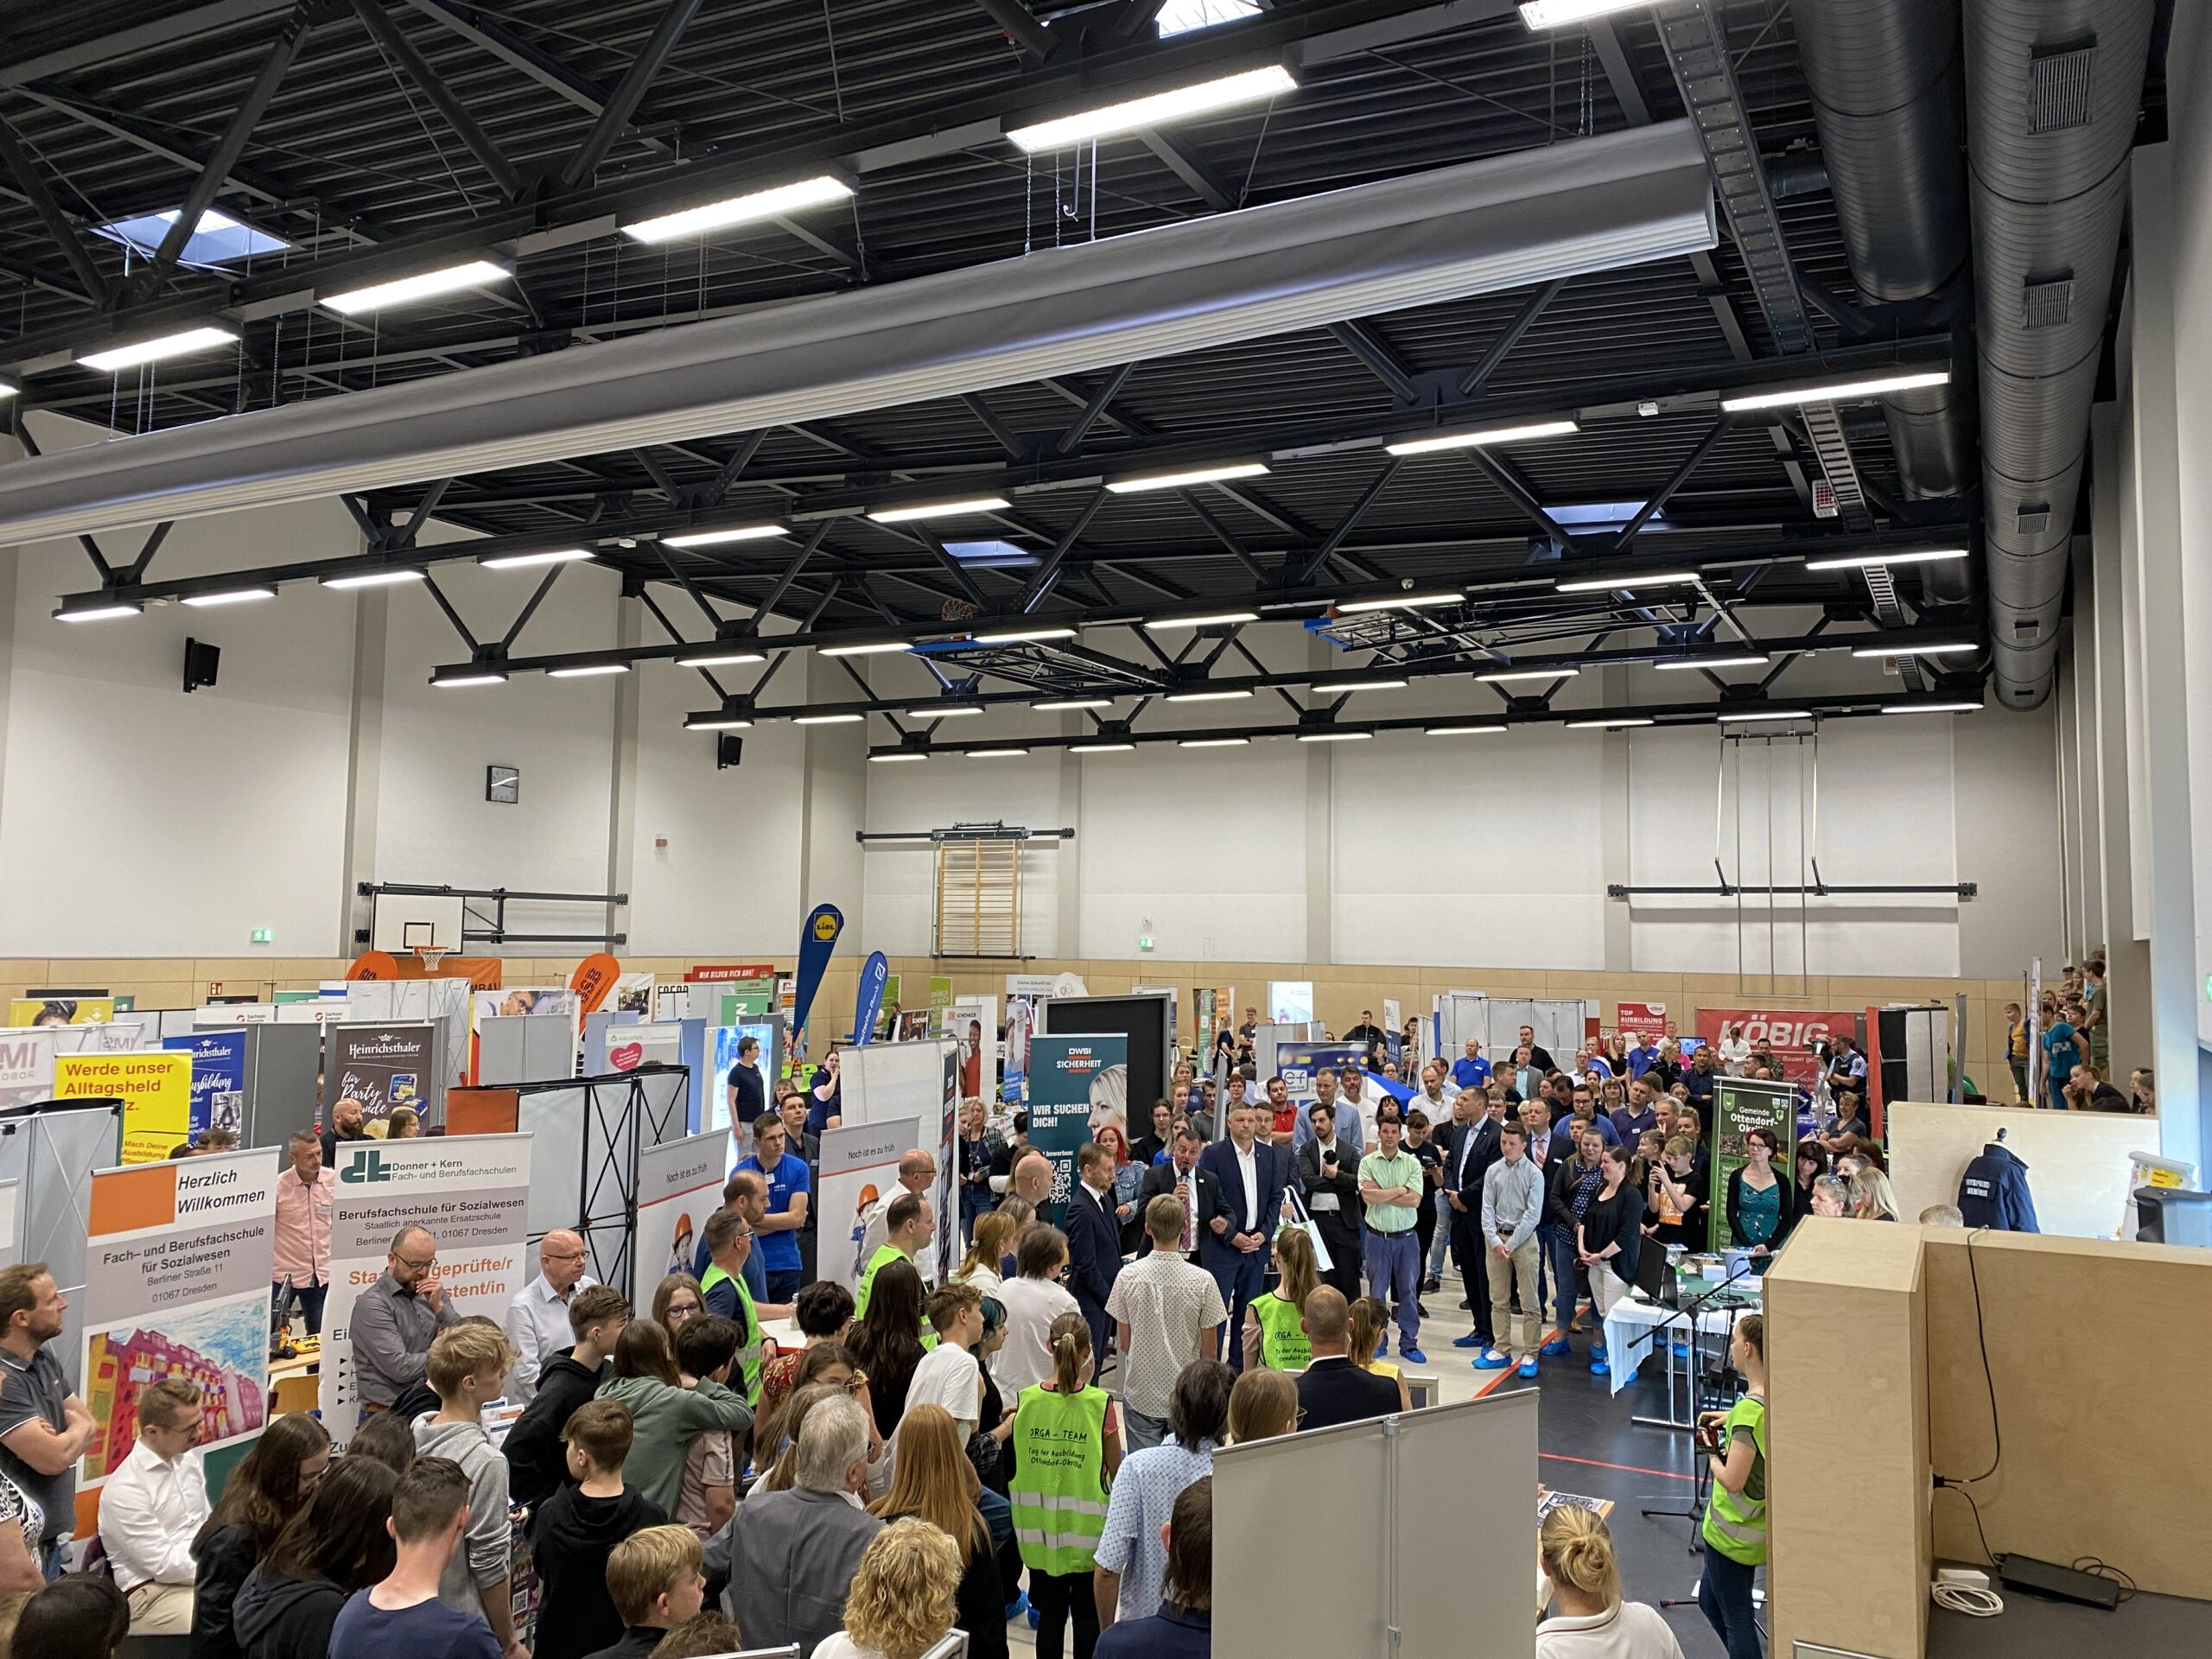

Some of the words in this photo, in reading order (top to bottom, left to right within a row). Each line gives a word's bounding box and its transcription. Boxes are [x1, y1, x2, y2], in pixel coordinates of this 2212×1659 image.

[699, 970, 709, 979] WIR
[710, 969, 728, 978] BILDEN
[729, 969, 741, 977] DICH
[1718, 1014, 1829, 1047] KÖBIG
[192, 1046, 232, 1058] nrichsthaler
[349, 1042, 421, 1059] Heinrichsthaler
[66, 1063, 119, 1077] Werde
[125, 1063, 173, 1076] unser
[1056, 1059, 1102, 1069] SICHERHEIT
[65, 1079, 161, 1096] Alltagsheld
[191, 1073, 232, 1094] usbildung
[341, 1071, 361, 1087] für
[340, 1082, 382, 1105] Party
[1033, 1104, 1052, 1116] WIR
[1053, 1103, 1090, 1115] SUCHEN
[1739, 1106, 1770, 1116] Gemeinde
[1033, 1116, 1058, 1128] DICH!
[1731, 1113, 1778, 1126] Ottendorf-
[848, 1150, 862, 1160] Noch
[884, 1143, 895, 1153] früh
[391, 1171, 417, 1181] Fach-
[419, 1170, 436, 1179] und
[439, 1166, 517, 1178] Berufsfachschulen
[392, 1161, 429, 1172] Donner
[440, 1160, 462, 1169] Kern
[666, 1173, 679, 1184] Noch
[698, 1162, 708, 1173] früh
[178, 1169, 238, 1191] Herzlich
[177, 1190, 265, 1214] Willkommen
[339, 1205, 438, 1221] Berufsfachschule
[441, 1202, 456, 1211] für
[459, 1198, 524, 1211] Sozialwesen
[365, 1220, 401, 1230] Staatlich
[403, 1216, 448, 1228] anerkannte
[450, 1212, 501, 1224] Ersatzschule
[143, 1243, 166, 1257] und
[168, 1227, 264, 1253] Berufsfachschule
[356, 1236, 392, 1246] Berliner
[442, 1229, 469, 1239] 01067
[471, 1226, 508, 1236] Dresden
[141, 1261, 156, 1274] für
[161, 1249, 231, 1270] Sozialwesen
[431, 1256, 513, 1280] geprüfte/r
[147, 1273, 181, 1287] Berliner
[183, 1267, 212, 1280] Straße
[214, 1263, 224, 1273] 11
[151, 1290, 181, 1303] 01067
[181, 1282, 218, 1297] Dresden
[1029, 1427, 1051, 1439] ORGA
[1063, 1429, 1088, 1442] TEAM
[1028, 1447, 1039, 1457] Tag
[1051, 1449, 1085, 1462] Ausbildung
